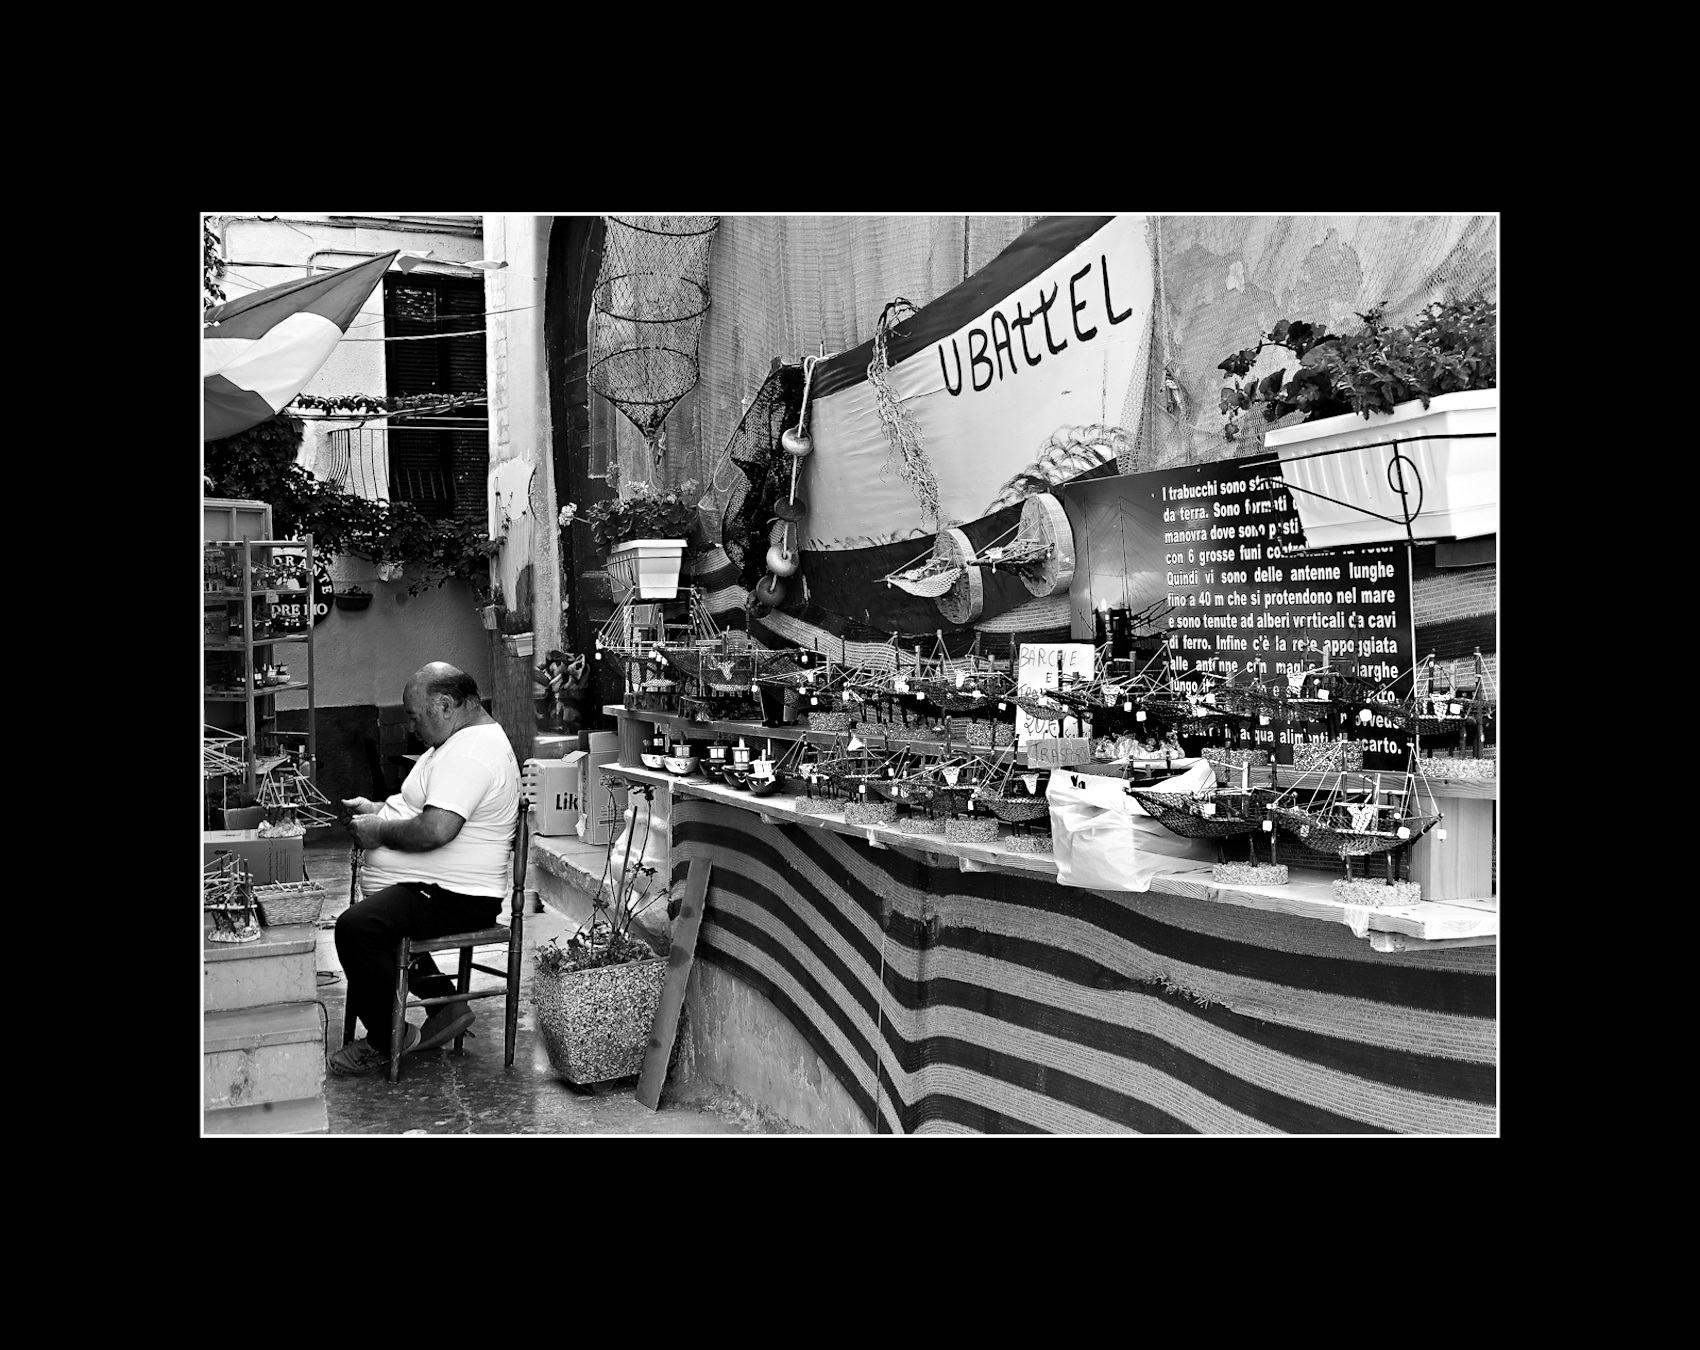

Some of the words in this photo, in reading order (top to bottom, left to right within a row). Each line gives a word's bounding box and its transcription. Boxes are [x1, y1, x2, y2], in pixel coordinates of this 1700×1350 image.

[1162, 486, 1167, 501] I
[1168, 480, 1218, 501] trabucchi
[1220, 480, 1247, 495] sono
[1163, 507, 1176, 523] da
[1180, 506, 1209, 521] terra.
[1213, 501, 1240, 518] Sono
[1164, 529, 1208, 544] manovra
[1210, 524, 1236, 540] dove
[1238, 524, 1266, 539] sono
[1165, 552, 1184, 565] con
[1188, 548, 1195, 563] 6
[1199, 549, 1235, 567] grosse
[1239, 543, 1262, 561] funi
[1166, 570, 1199, 587] Quindi
[1204, 568, 1215, 584] vi
[1220, 571, 1247, 584] sono
[1253, 566, 1283, 583] delle
[1290, 565, 1341, 582] antenne
[1348, 561, 1395, 583] lunghe
[1167, 592, 1187, 607] fino
[1189, 594, 1196, 607] a
[1198, 591, 1211, 607] 40
[1214, 593, 1224, 607] m
[1227, 591, 1248, 606] che
[1250, 590, 1261, 606] si
[1263, 588, 1334, 609] protendono
[1336, 587, 1357, 604] nel
[1360, 589, 1396, 604] mare
[1168, 616, 1175, 629] e
[1176, 616, 1201, 629] sono
[1203, 613, 1238, 629] tenute
[1240, 612, 1254, 629] ad
[1256, 611, 1290, 629] alberi
[1367, 610, 1397, 629] cavi
[1169, 634, 1179, 650] di
[1183, 634, 1212, 650] ferro.
[1216, 634, 1248, 651] Infine
[1252, 635, 1270, 651] c'è
[1275, 635, 1287, 652] la
[1170, 655, 1189, 671] alle
[1357, 660, 1399, 683] larghe
[1170, 676, 1198, 696] lungo
[1357, 736, 1402, 755] carto.
